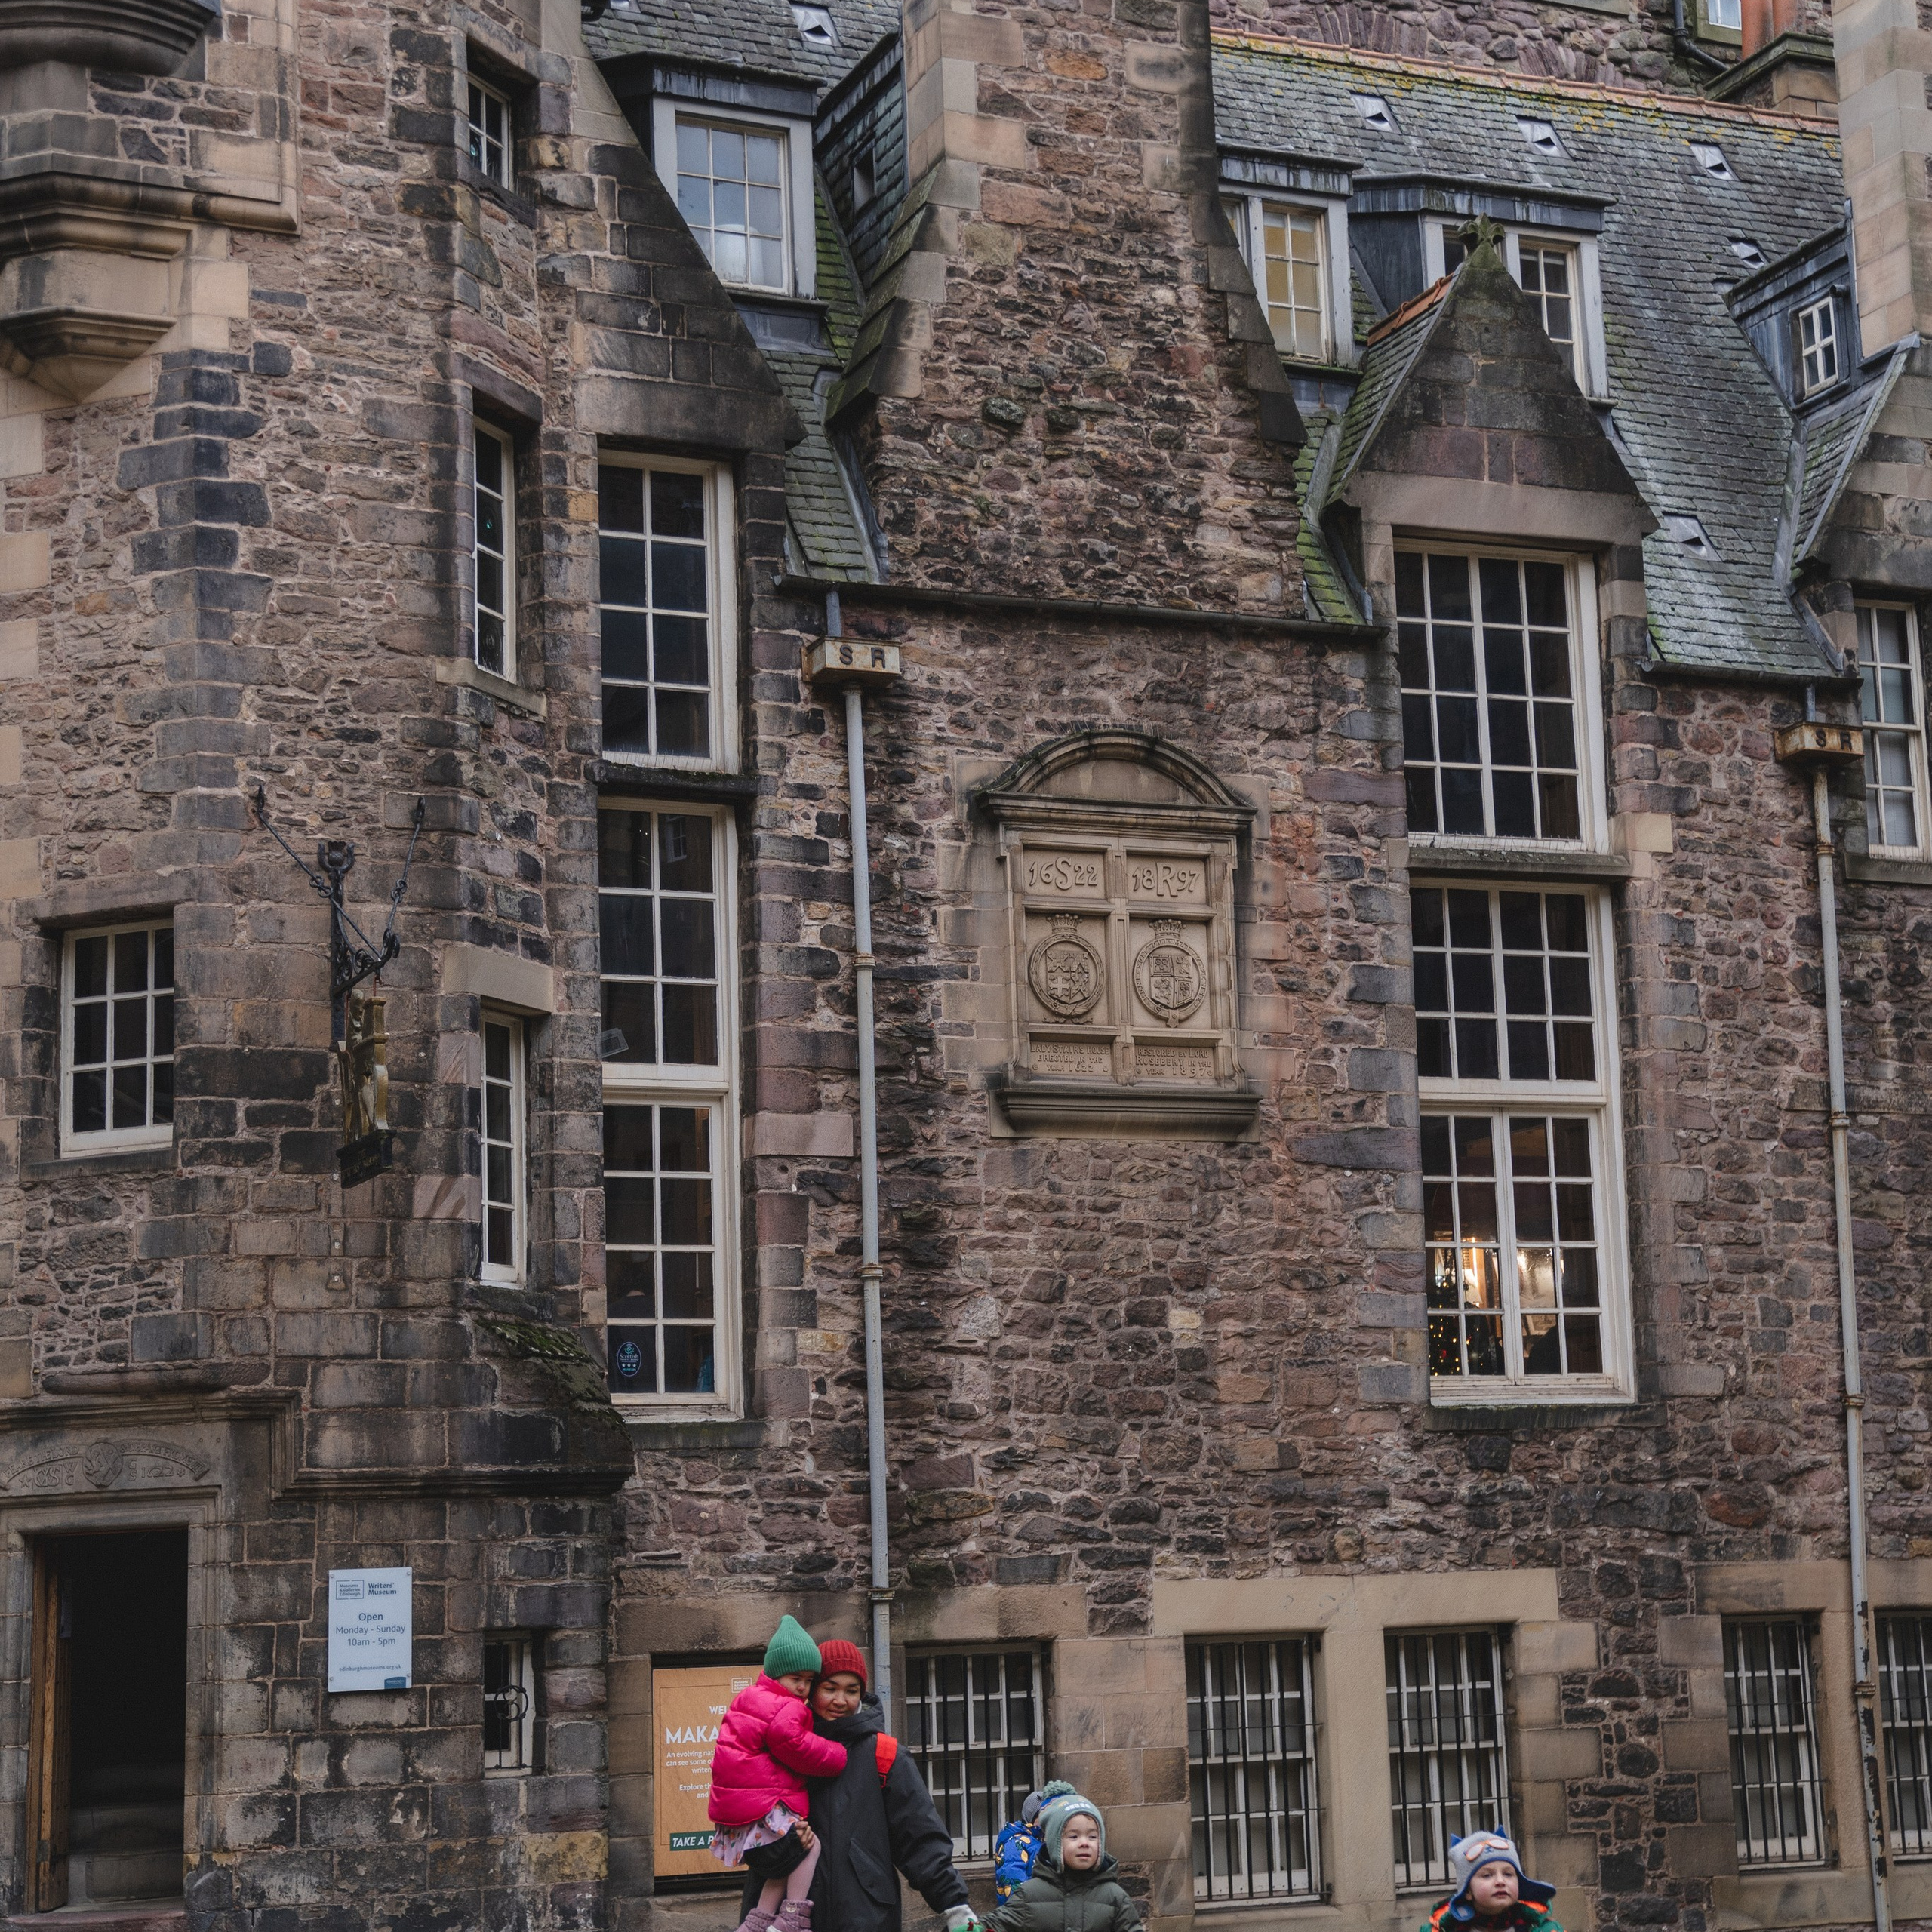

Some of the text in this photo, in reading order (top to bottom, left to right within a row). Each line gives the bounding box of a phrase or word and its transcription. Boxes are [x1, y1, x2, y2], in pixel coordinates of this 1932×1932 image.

[840, 644, 886, 669] S R
[1815, 728, 1852, 751] S R
[1030, 1044, 1109, 1055] LADY STAIRS HOUSE
[1138, 1048, 1175, 1057] RESTORED
[1189, 1048, 1208, 1058] LORD
[1038, 1054, 1074, 1063] ERECTED
[1136, 1056, 1184, 1066] ROSEBERY
[1069, 1063, 1094, 1072] 1622
[1172, 1067, 1206, 1078] 1897
[358, 1612, 383, 1623] Open
[336, 1626, 368, 1636] Monday
[376, 1624, 406, 1634] Sunday
[378, 1637, 396, 1647] 5pm
[339, 1664, 401, 1672] edinburghmuseums.org.uk
[666, 1725, 720, 1744] MAKA
[672, 1836, 696, 1847] TAKE
[697, 1835, 706, 1846] A
